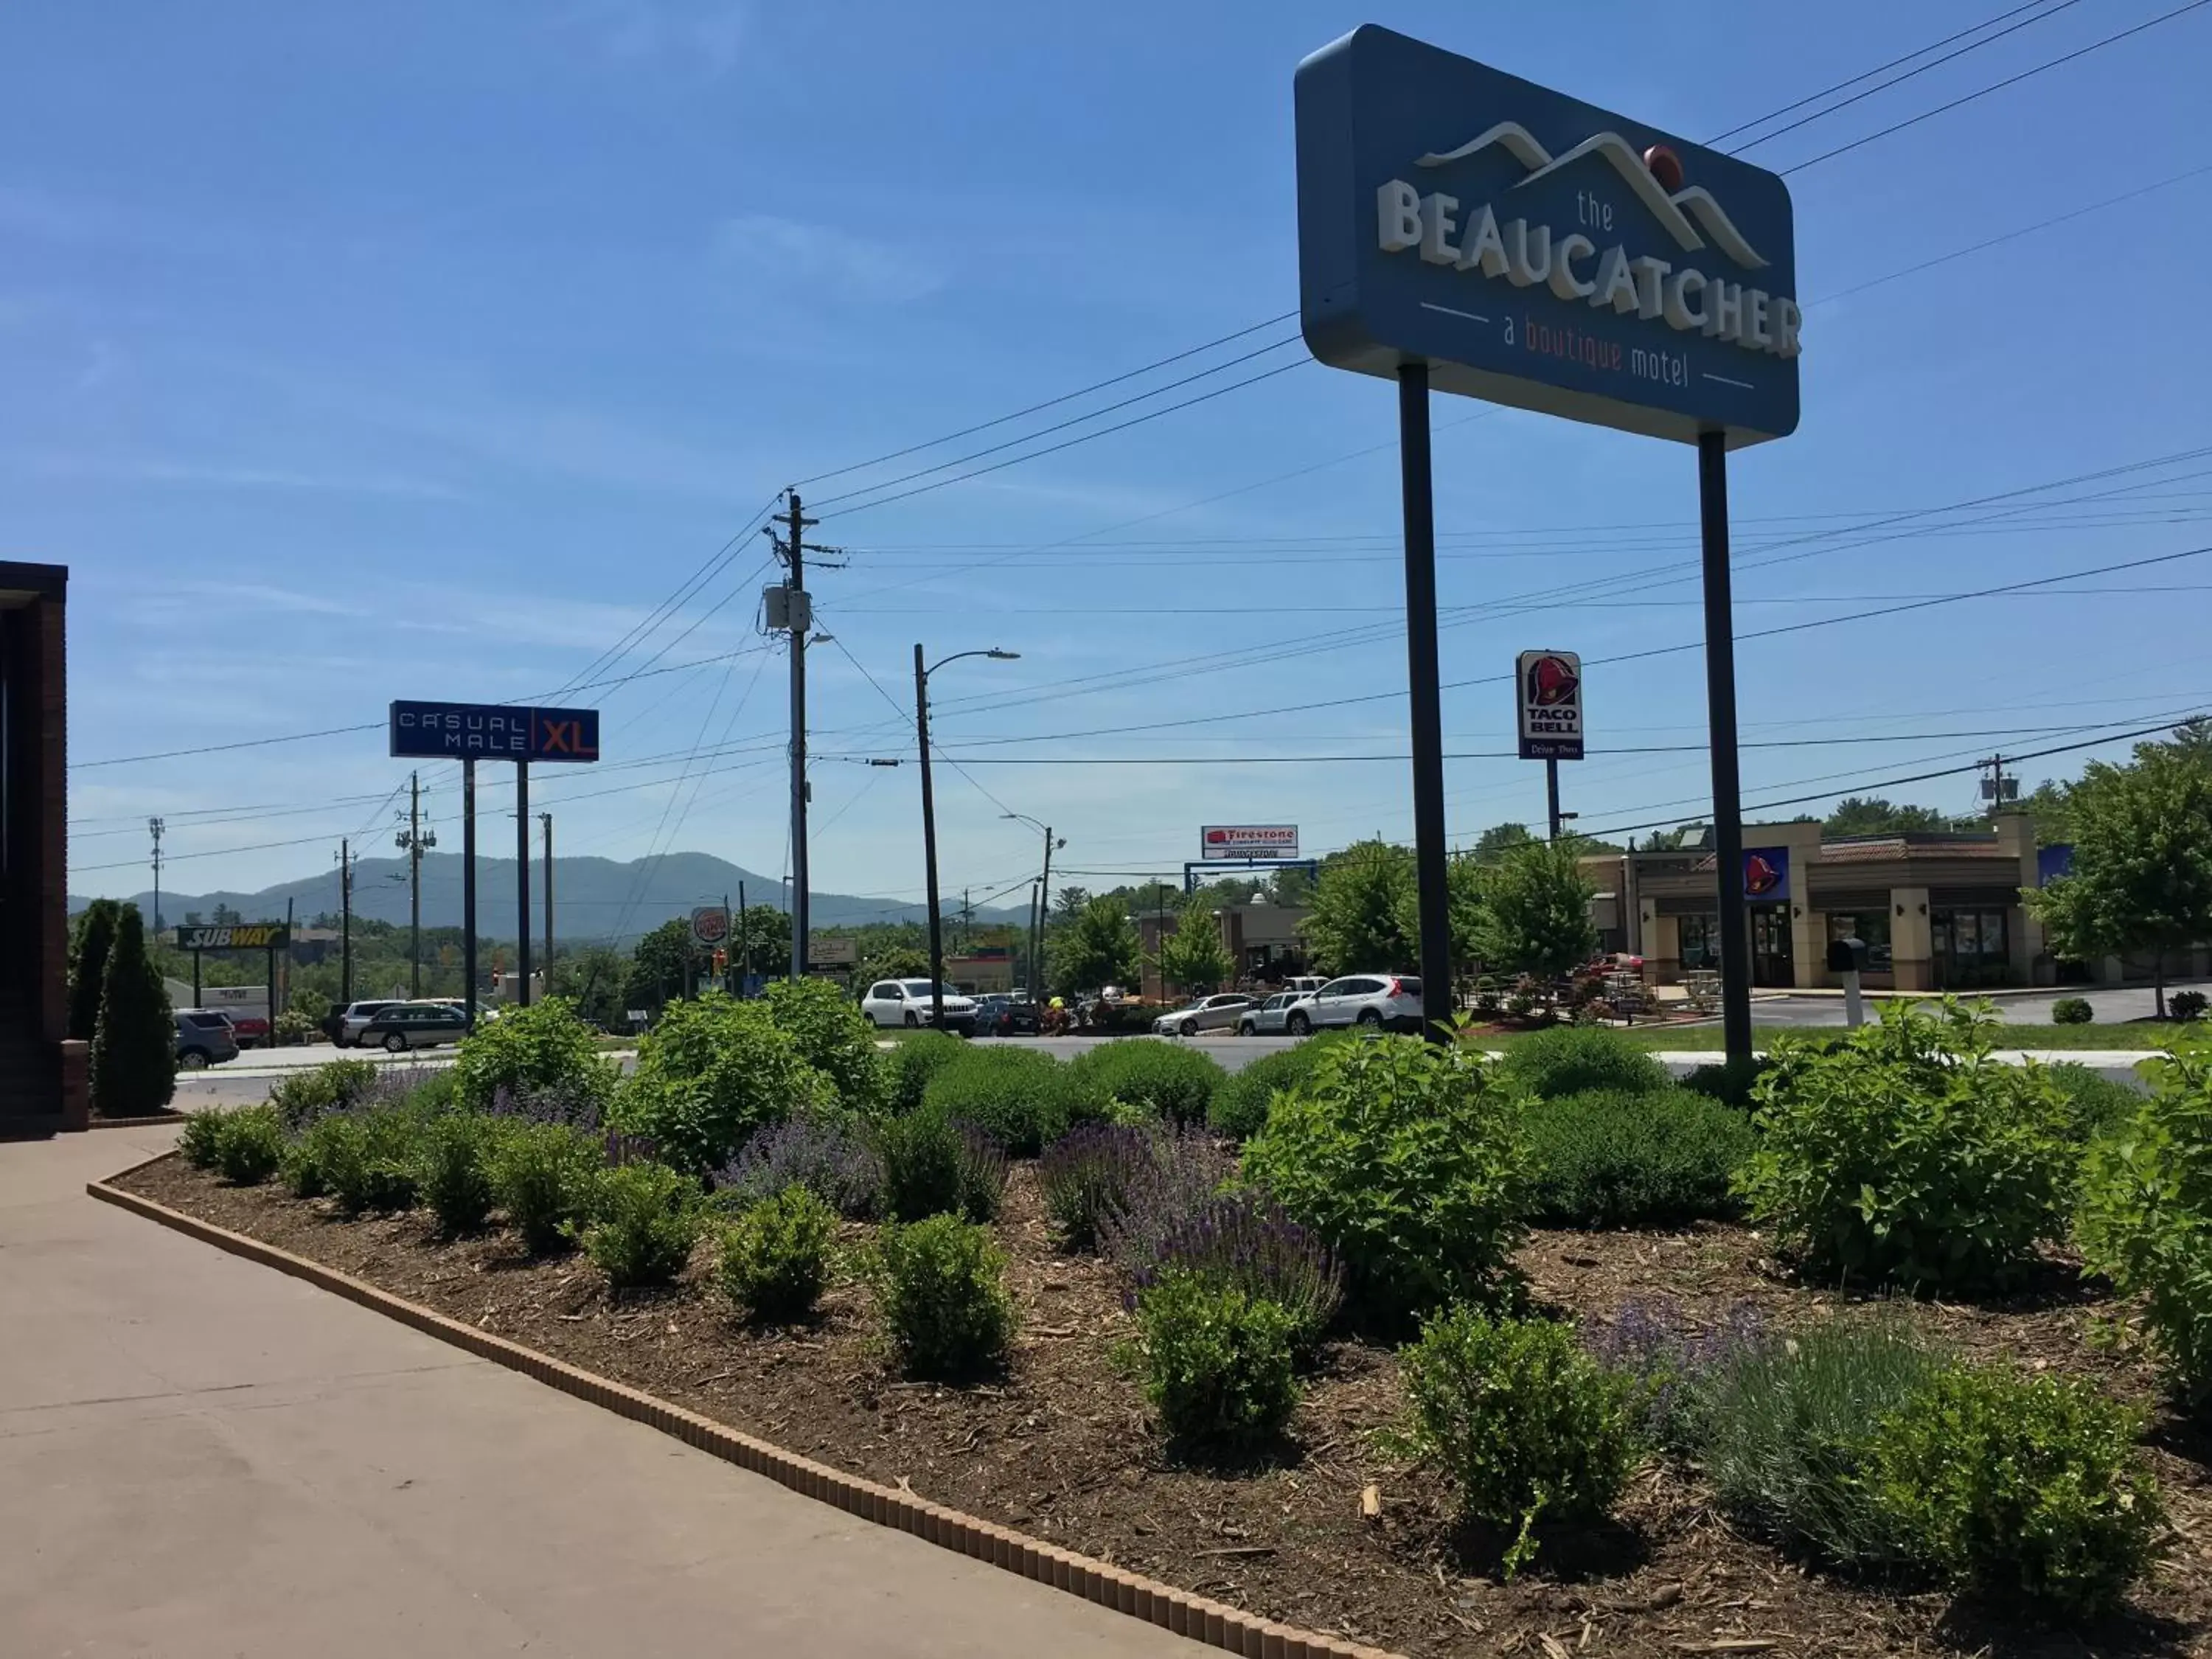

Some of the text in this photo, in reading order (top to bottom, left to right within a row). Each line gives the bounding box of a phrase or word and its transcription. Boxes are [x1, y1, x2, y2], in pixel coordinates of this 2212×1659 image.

[1577, 190, 1613, 231] the
[1377, 179, 1801, 358] BEAUCATCHER
[1504, 315, 1688, 386] a boutique motel
[400, 713, 525, 732] CASUAL
[1528, 709, 1576, 720] TACO
[543, 720, 597, 753] XL
[1531, 722, 1579, 732] BELL
[445, 734, 525, 750] MALE
[1228, 830, 1294, 839] Firestone
[187, 927, 283, 947] SUBWAY
